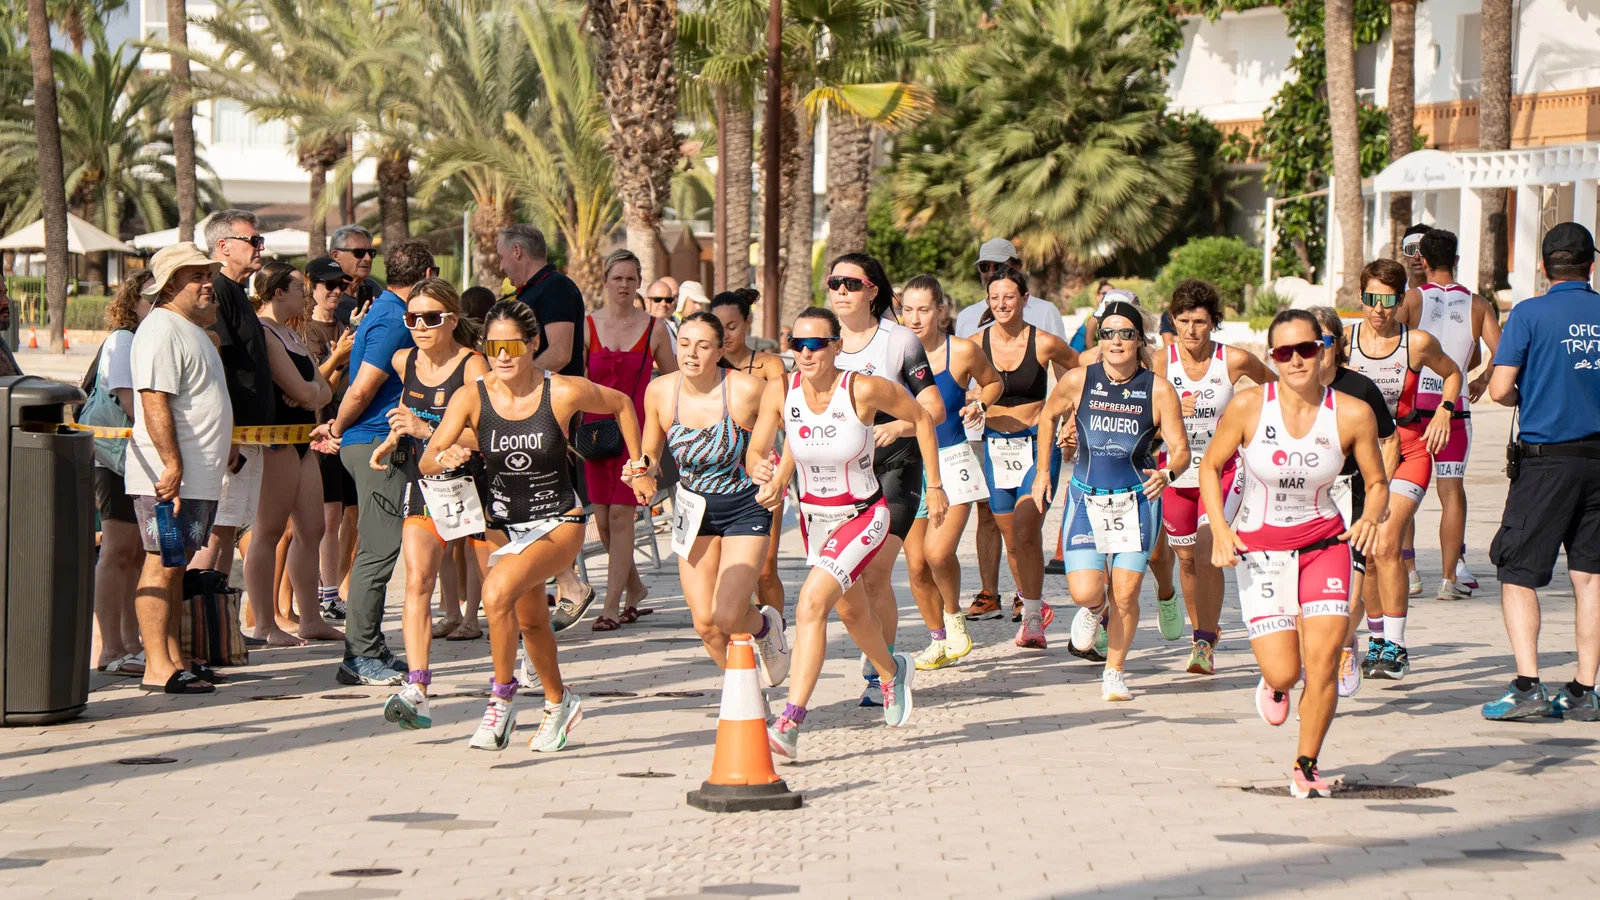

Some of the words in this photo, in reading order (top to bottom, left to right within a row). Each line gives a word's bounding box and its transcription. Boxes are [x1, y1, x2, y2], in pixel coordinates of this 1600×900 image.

[1569, 324, 1600, 337] OFIC
[1089, 400, 1143, 414] SEMPRERAPID
[1184, 407, 1216, 419] RMEN
[799, 425, 837, 439] one
[1090, 415, 1139, 435] VAQUERO
[490, 430, 543, 452] Leonor
[1004, 460, 1023, 471] 10
[1272, 450, 1319, 467] one
[959, 468, 970, 481] 3
[1279, 478, 1305, 489] MAR
[442, 500, 465, 518] 13
[676, 515, 683, 531] 1
[1103, 517, 1124, 532] 15
[819, 558, 844, 577] HALF
[1261, 582, 1275, 598] 5
[1304, 603, 1331, 616] IBIZA
